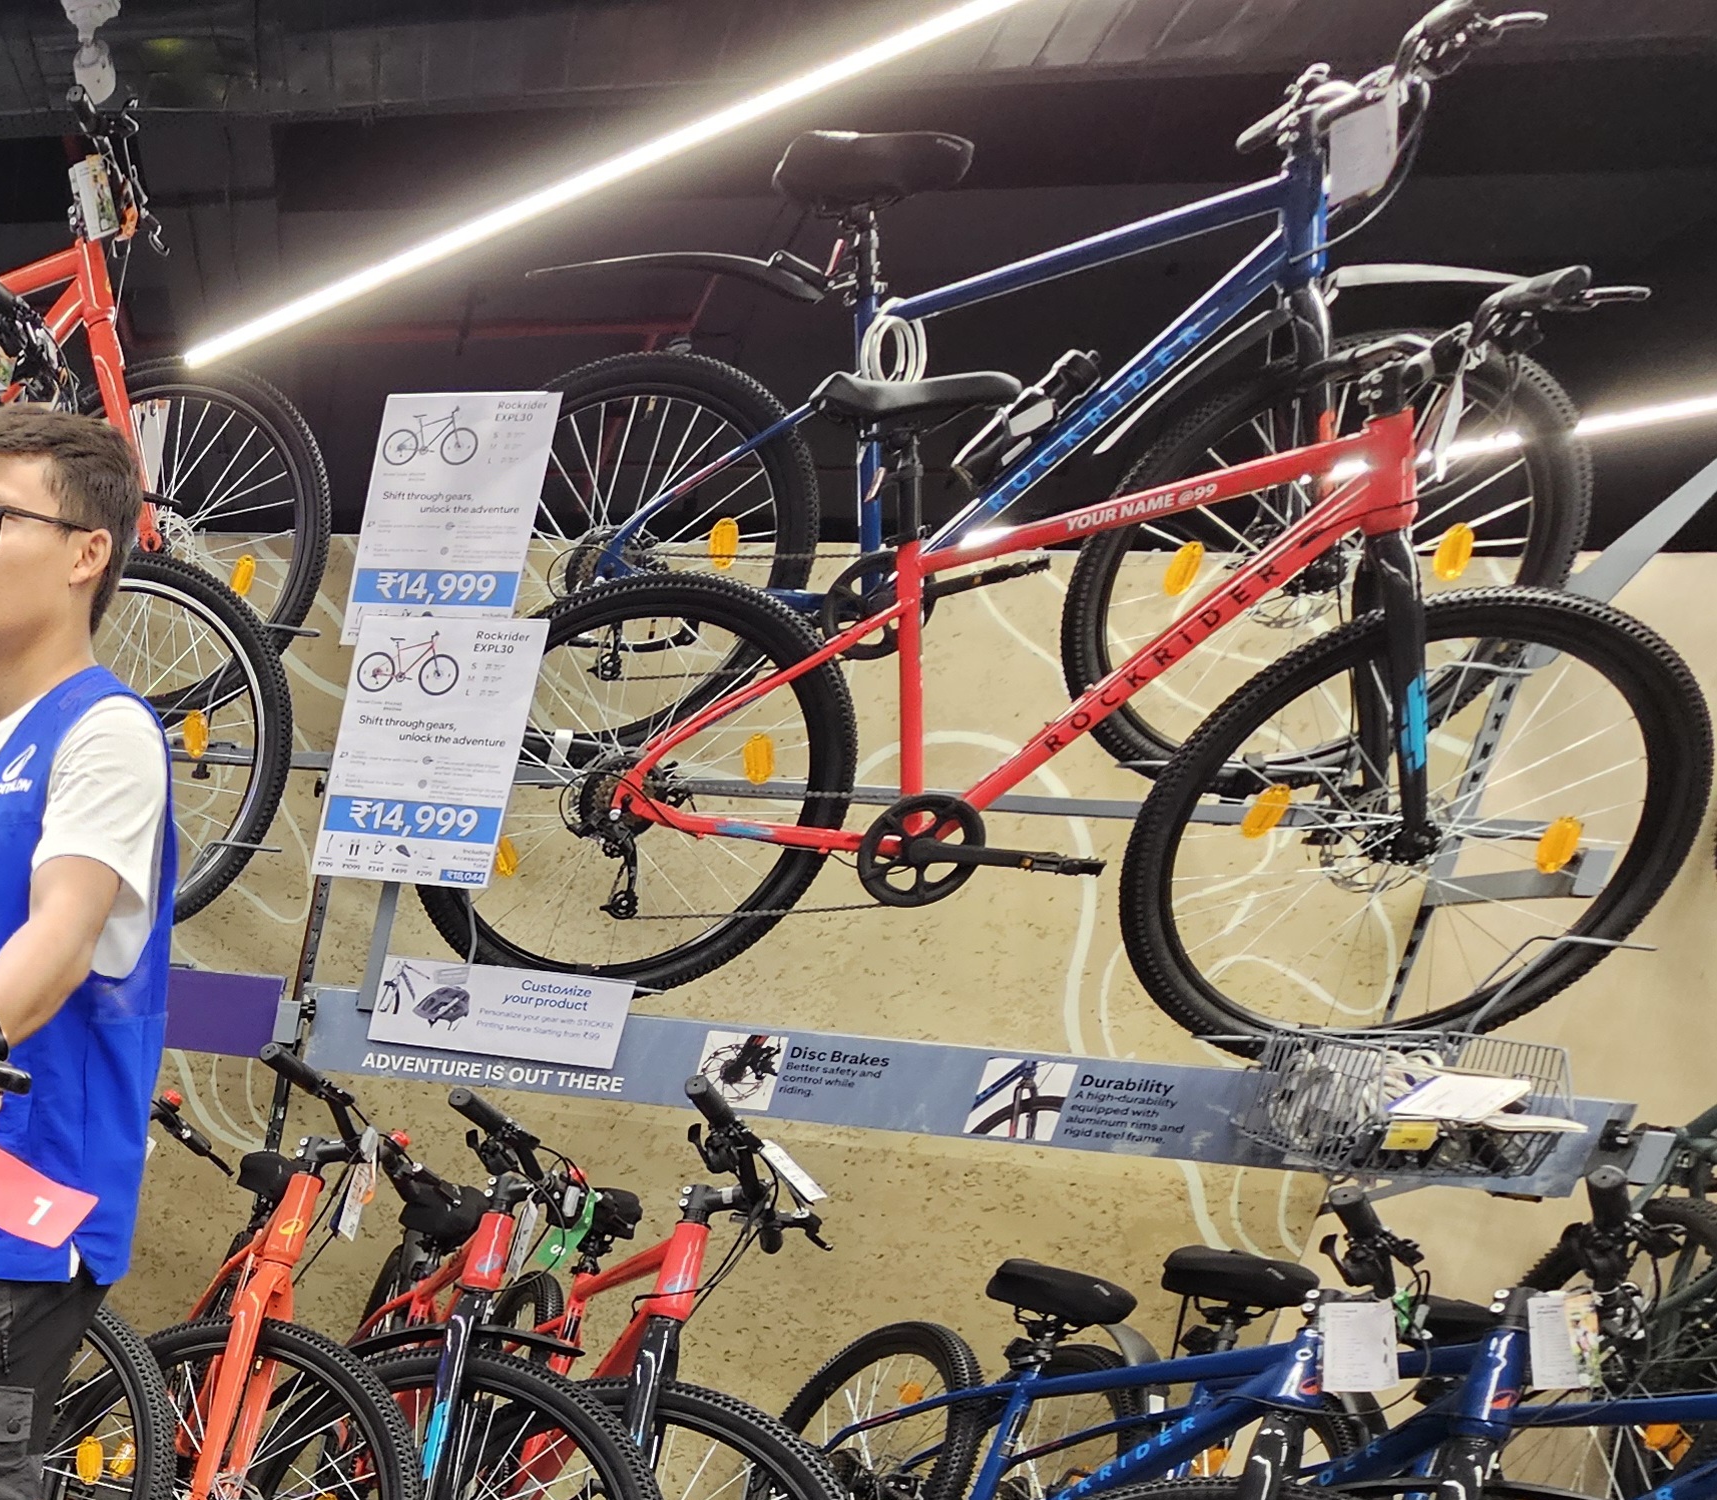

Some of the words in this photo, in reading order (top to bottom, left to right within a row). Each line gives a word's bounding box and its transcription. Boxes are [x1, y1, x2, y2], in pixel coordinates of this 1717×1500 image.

[497, 401, 548, 410] Rockrider
[495, 413, 533, 422] EXPL30
[988, 326, 1202, 511] ROCKRIDER
[383, 491, 406, 501] Shift
[407, 492, 444, 503] through
[445, 493, 474, 503] gears,
[420, 504, 451, 514] unlock
[453, 505, 469, 514] the
[470, 505, 520, 514] adventure
[1066, 507, 1117, 531] YOUR
[1120, 492, 1174, 519] NAME
[1177, 483, 1218, 505] @99
[376, 571, 497, 605] ₹14,999
[476, 630, 531, 642] Rockrider
[473, 643, 515, 654] EXPL30
[1043, 563, 1281, 753] ROCKRIDER
[359, 715, 385, 726] Shift
[385, 717, 425, 731] through
[426, 721, 457, 732] gears,
[399, 733, 433, 744] unlock
[434, 734, 451, 745] the
[453, 736, 506, 748] adventure
[349, 799, 479, 838] ₹14,999
[521, 979, 592, 998] Customize
[502, 993, 533, 1005] your
[534, 997, 589, 1011] product
[479, 1008, 521, 1018] Personalize
[577, 1019, 614, 1029] STICKER
[476, 1019, 504, 1031] Printing
[505, 1024, 532, 1032] service
[533, 1027, 562, 1038] Starting
[583, 1031, 601, 1041] ₹99
[790, 1046, 827, 1062] Disc
[830, 1050, 891, 1067] Brakes
[361, 1052, 482, 1079] ADVENTURE
[485, 1064, 506, 1081] IS
[509, 1067, 554, 1086] OUT
[556, 1071, 625, 1093] THERE
[786, 1061, 820, 1073] Better
[822, 1065, 857, 1078] safety
[859, 1069, 883, 1079] and
[782, 1073, 823, 1085] control
[825, 1077, 855, 1088] while
[1080, 1074, 1175, 1096] Durability
[778, 1084, 814, 1098] riding.
[1074, 1090, 1084, 1099] A
[1086, 1091, 1178, 1109] high-durability
[1070, 1103, 1130, 1116] equipped
[1131, 1108, 1159, 1118] with
[1066, 1115, 1127, 1128] aluminum
[1130, 1121, 1157, 1131] rims
[1159, 1124, 1185, 1134] and
[1064, 1127, 1093, 1138] rigid
[1095, 1129, 1125, 1140] steel
[1127, 1132, 1166, 1145] frame.
